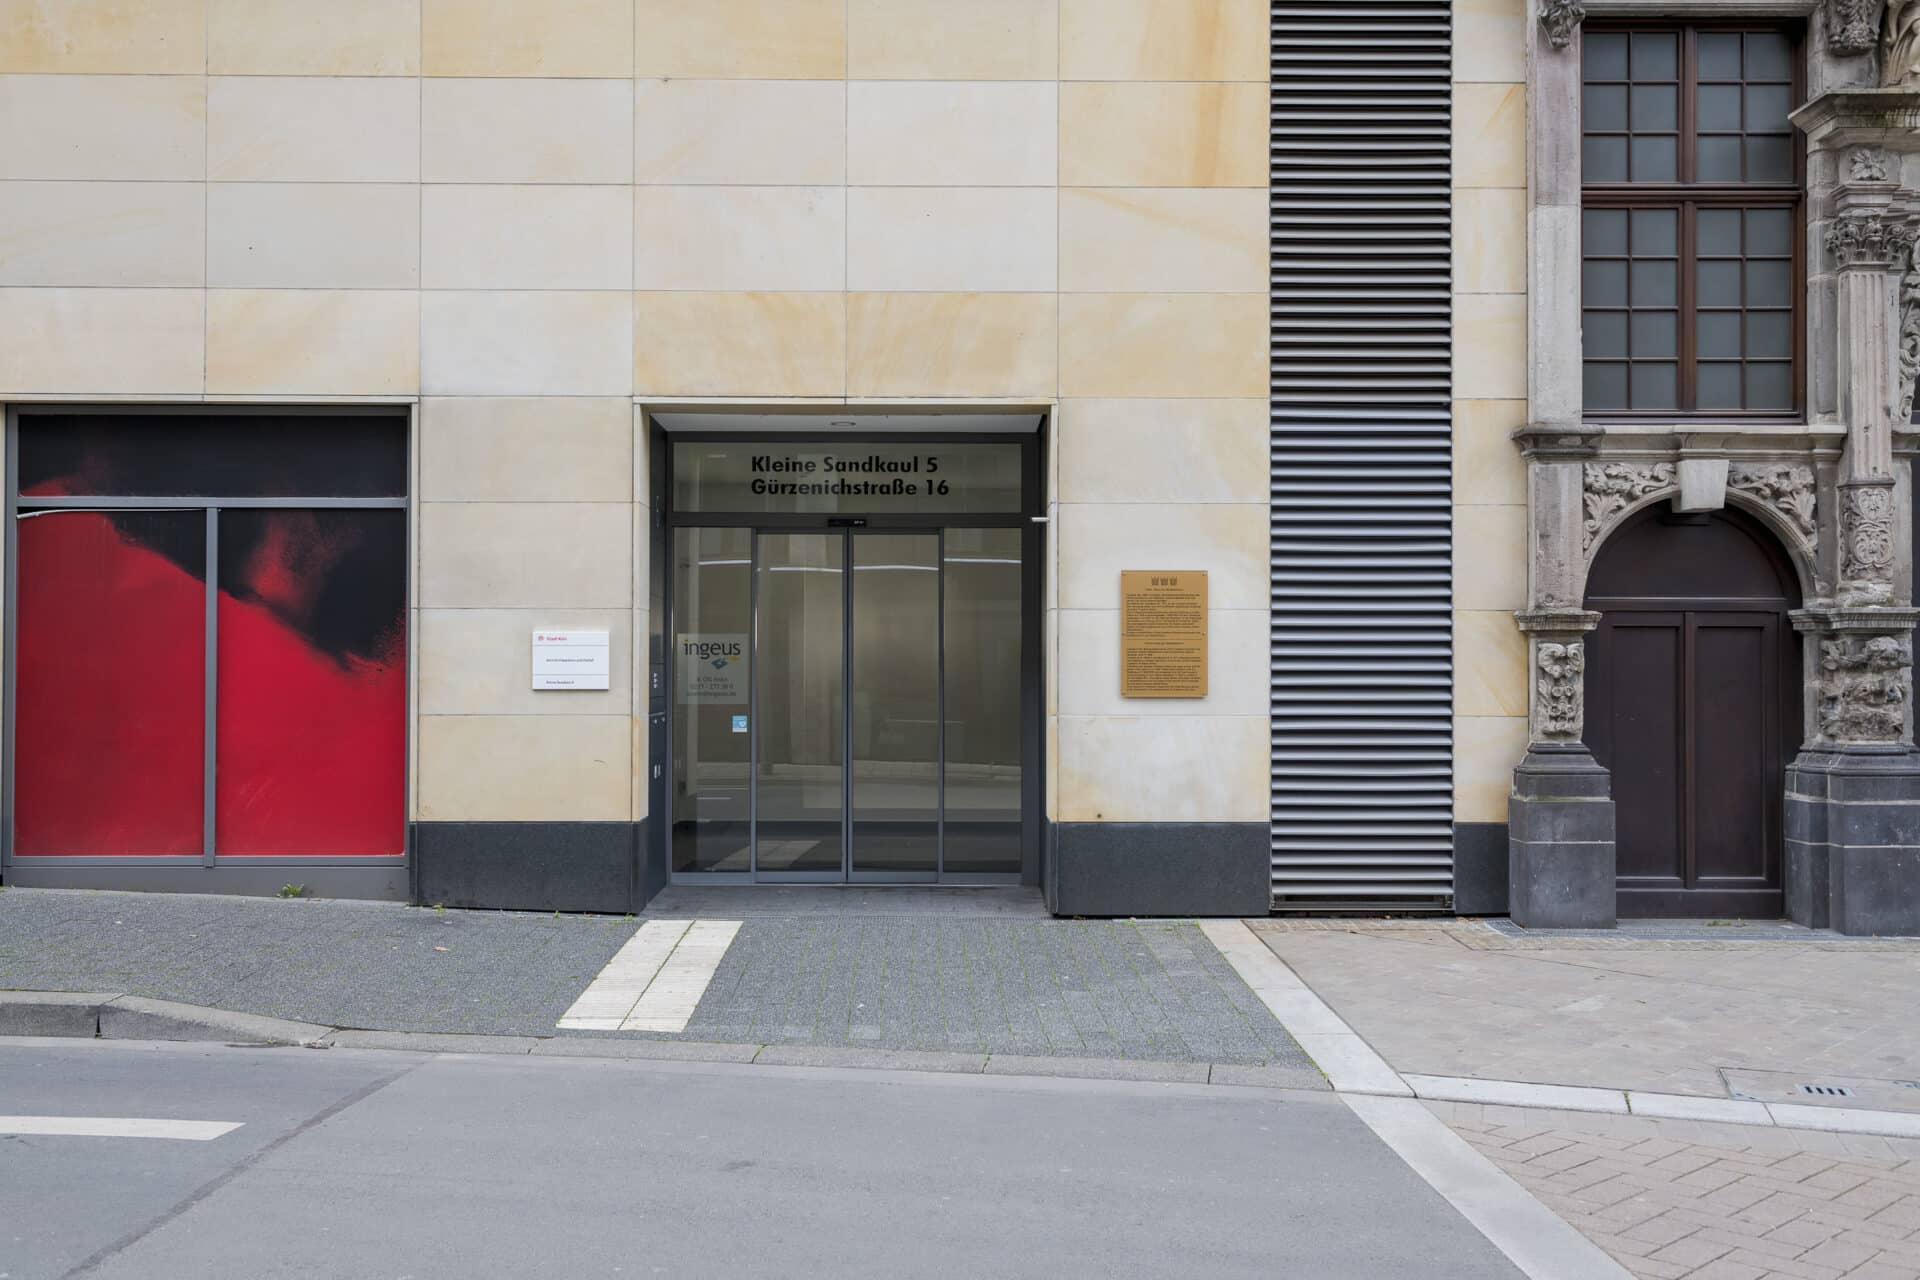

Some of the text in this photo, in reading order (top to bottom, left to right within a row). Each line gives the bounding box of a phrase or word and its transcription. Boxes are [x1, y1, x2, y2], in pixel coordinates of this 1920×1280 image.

[751, 456, 938, 473] Kleine Sandkaul 5
[751, 478, 950, 496] Gürzenichstraße 16
[683, 639, 741, 660] ingeus
